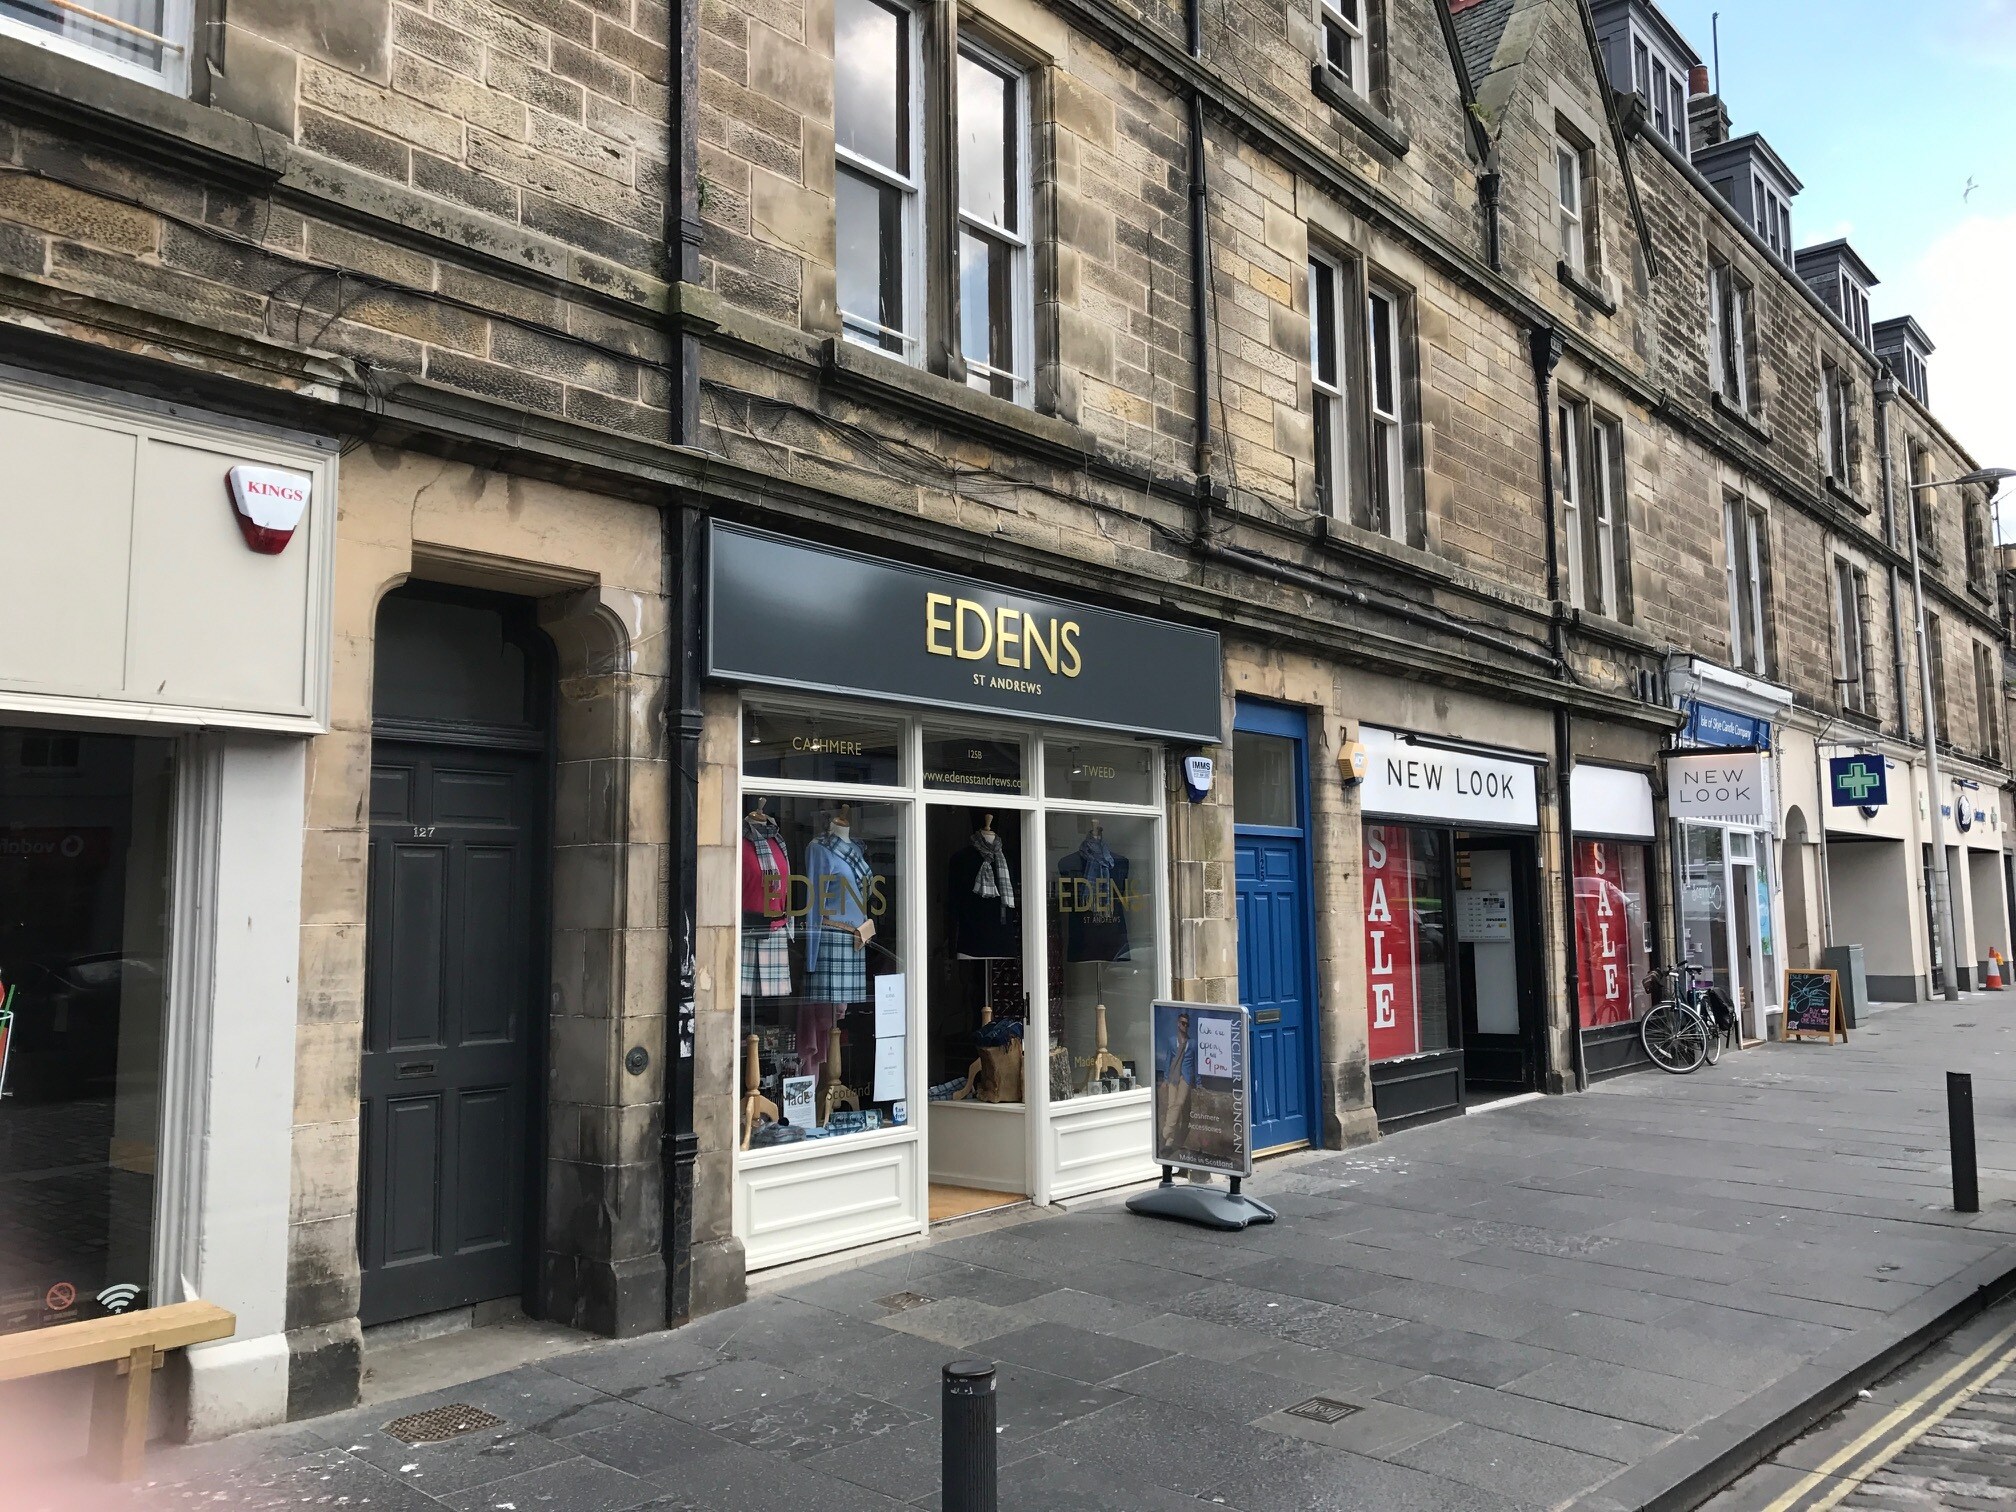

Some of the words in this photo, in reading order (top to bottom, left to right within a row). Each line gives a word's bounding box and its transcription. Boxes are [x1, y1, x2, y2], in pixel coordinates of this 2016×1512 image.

[248, 481, 303, 501] KINGS
[926, 592, 1082, 678] EDENS
[973, 673, 986, 687] ST
[989, 676, 1042, 695] ANDREWS
[792, 736, 862, 756] CASHMERE
[967, 749, 983, 760] 125B
[1083, 764, 1115, 779] TWEED
[1192, 760, 1211, 771] IMMS
[1387, 758, 1442, 791] NEW
[1456, 767, 1514, 800] LOOK
[1684, 768, 1744, 785] NEW
[1679, 786, 1751, 803] LOOK
[413, 826, 436, 838] 127
[763, 874, 887, 918] EDENS
[1367, 826, 1396, 1029] SALE
[1594, 843, 1619, 1000] SALE
[1230, 1019, 1242, 1083] SINCLAIR
[1205, 1057, 1212, 1072] 9
[1213, 1063, 1228, 1075] pm
[826, 1081, 871, 1101] Scotland
[1189, 1111, 1220, 1122] Cashmere
[1232, 1088, 1244, 1154] DUNCAN
[1179, 1153, 1196, 1162] Made
[1205, 1158, 1234, 1169] Scotland
